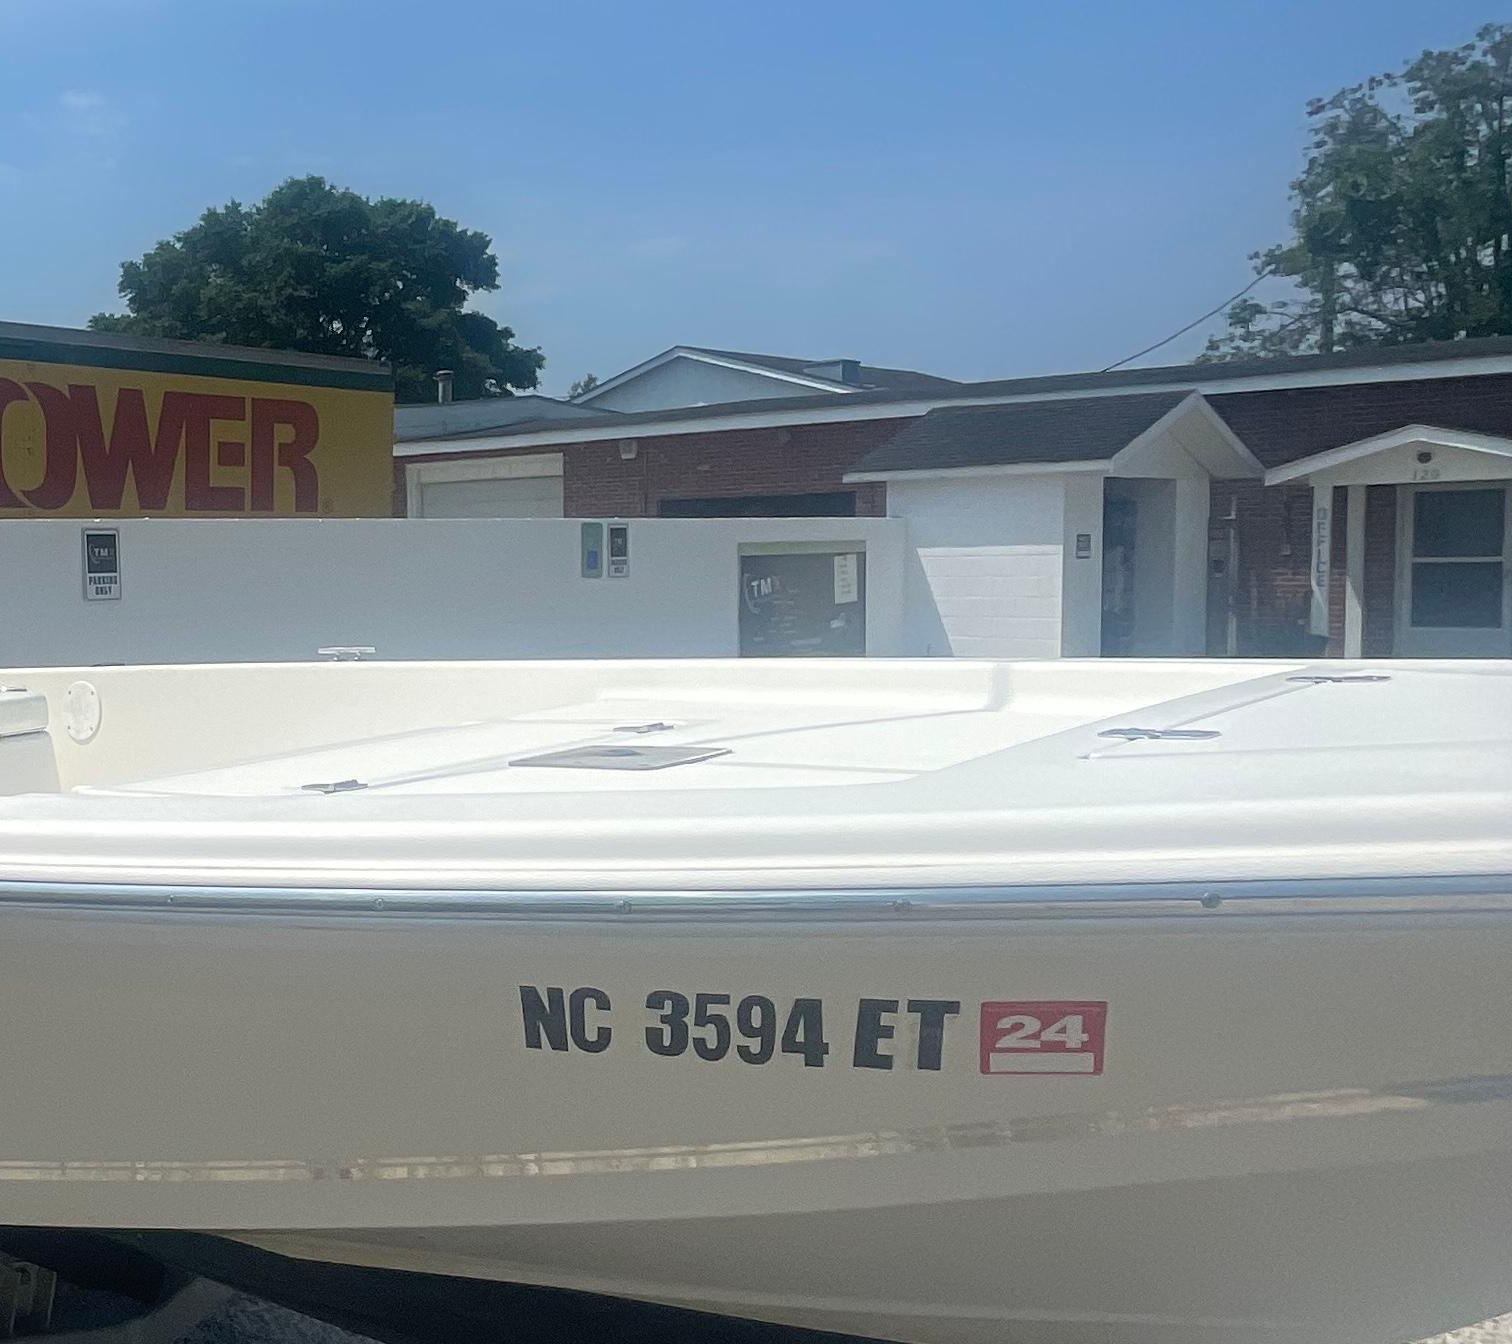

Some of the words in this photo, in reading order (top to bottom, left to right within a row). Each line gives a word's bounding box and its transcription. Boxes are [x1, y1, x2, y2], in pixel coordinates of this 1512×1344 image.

[519, 985, 612, 1054] NC
[645, 989, 829, 1068] 3594
[853, 998, 961, 1072] ET
[994, 1014, 1089, 1049] 24
